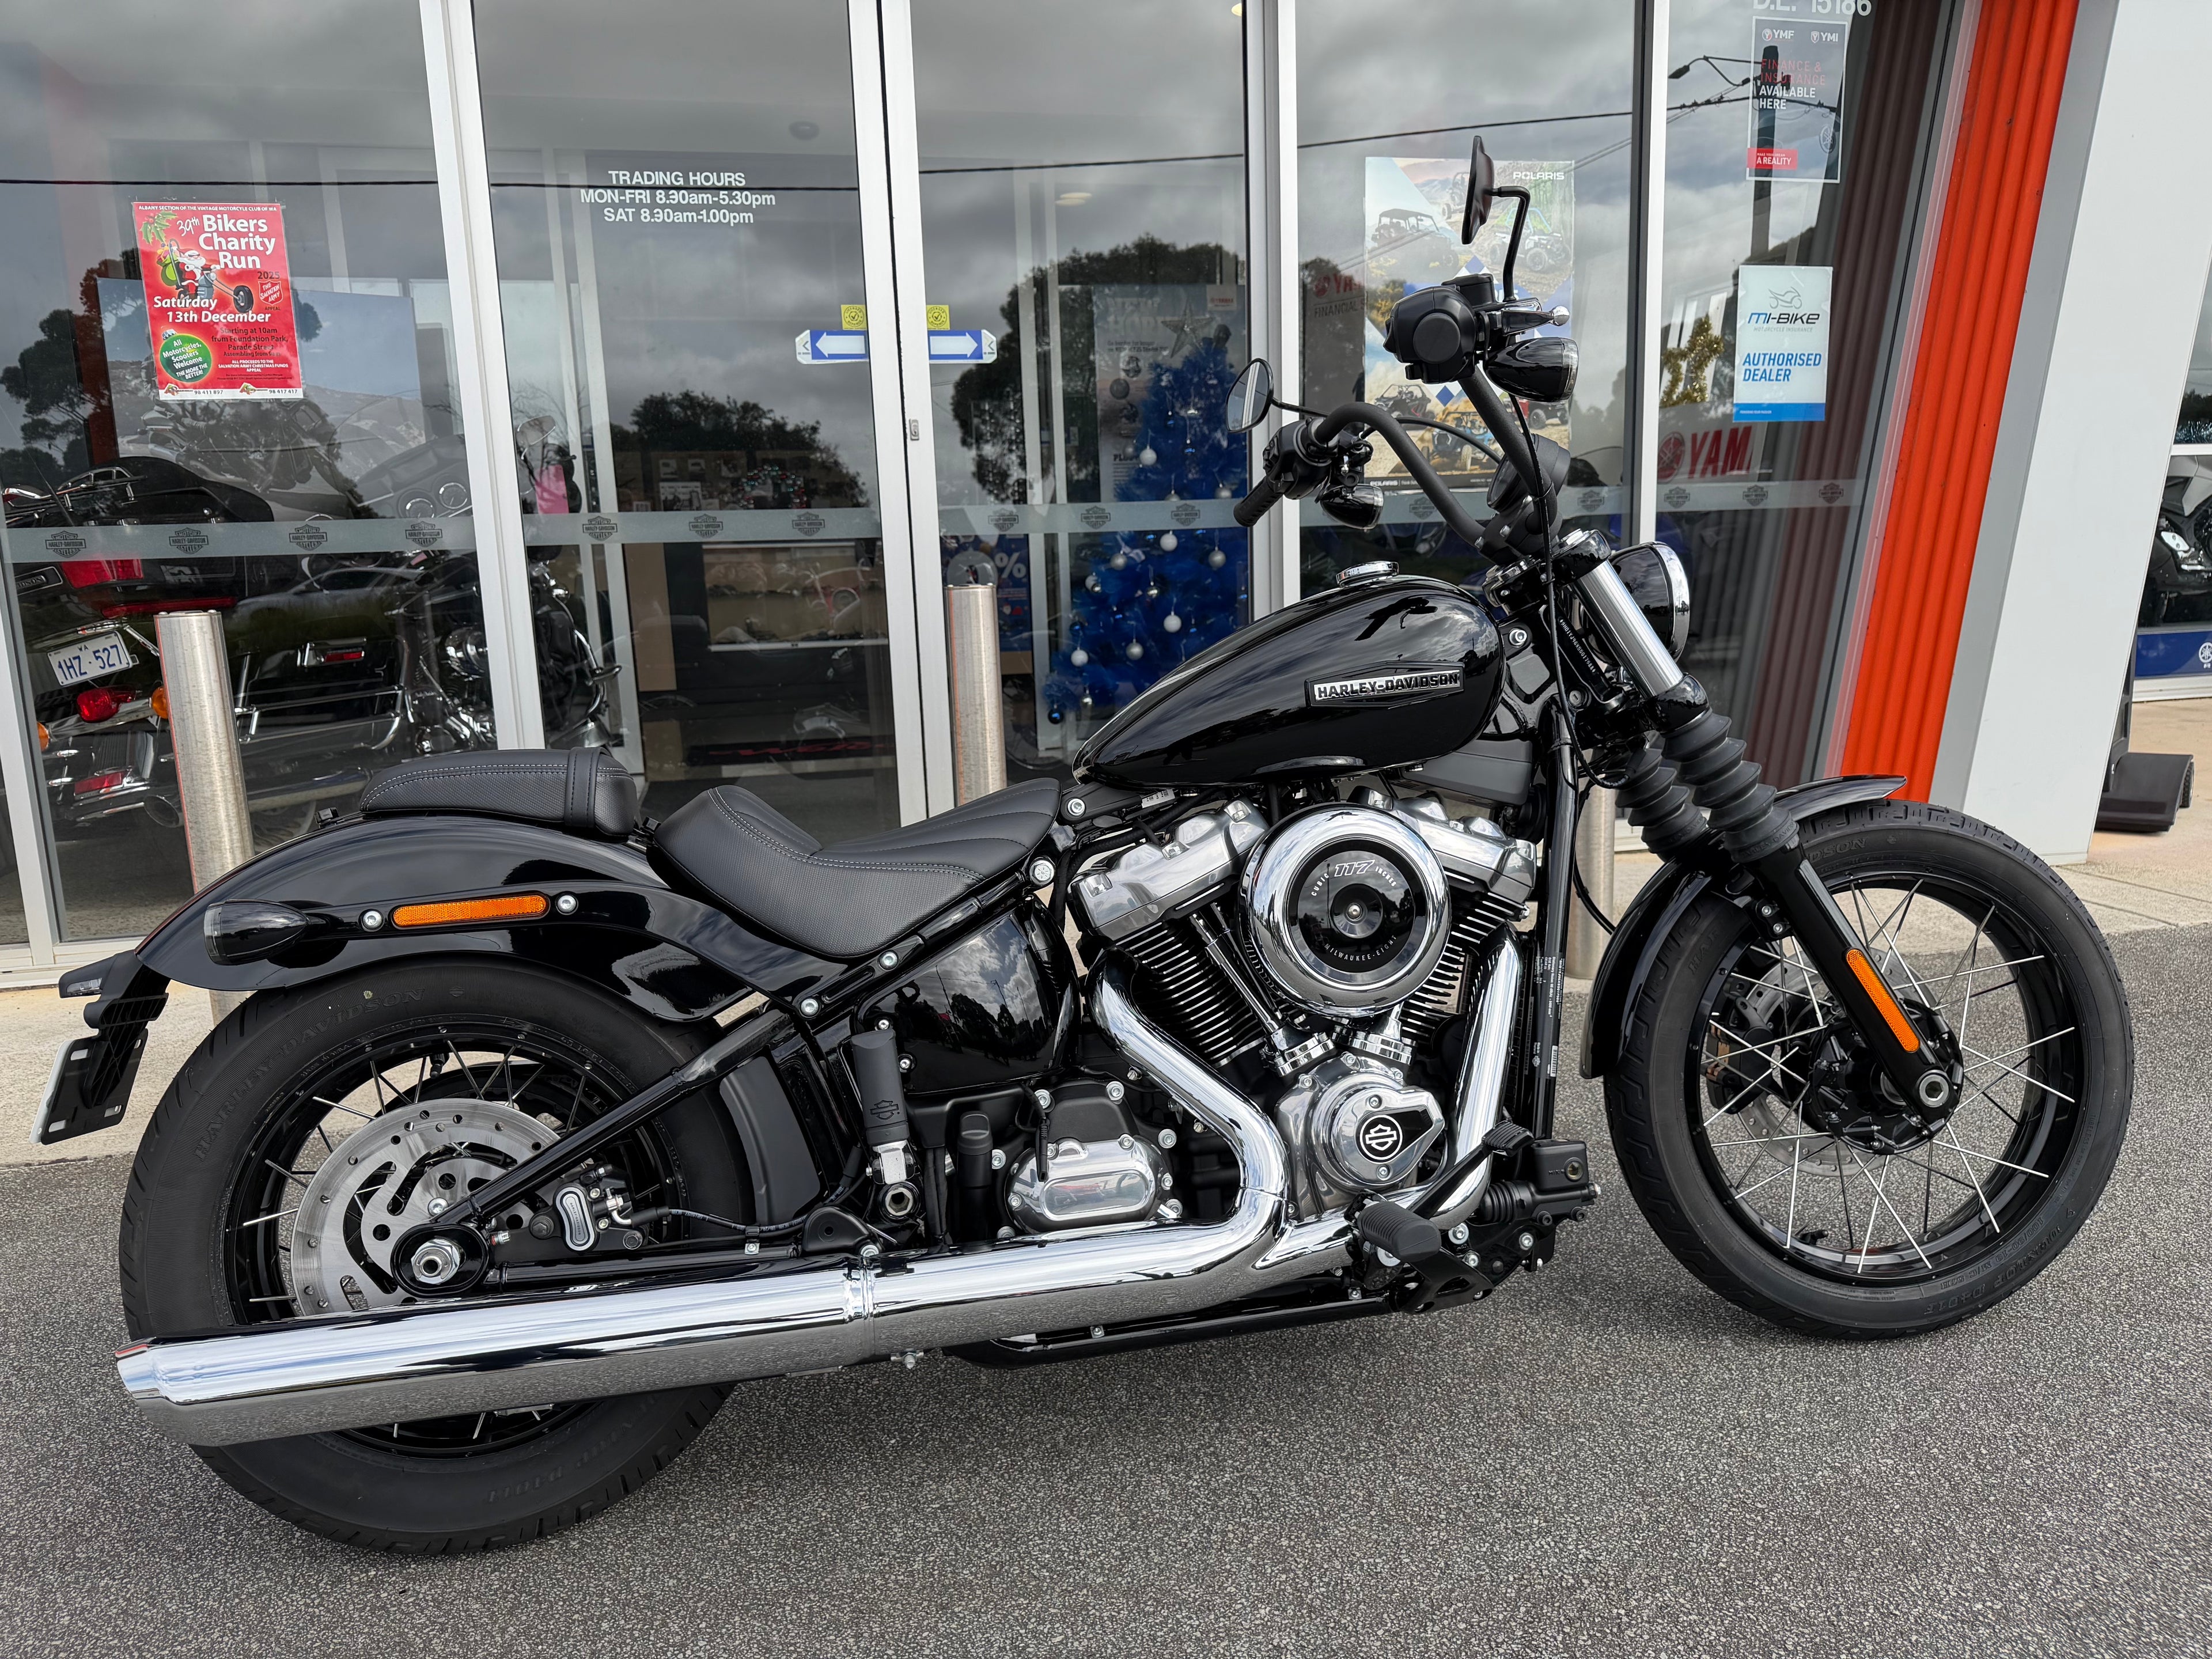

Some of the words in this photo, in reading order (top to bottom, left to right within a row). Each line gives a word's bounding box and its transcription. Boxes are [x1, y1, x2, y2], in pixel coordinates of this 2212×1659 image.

[1773, 29, 1795, 39] YMF
[1820, 32, 1839, 42] YMI
[1762, 59, 1810, 71] FINANCE
[1815, 62, 1821, 72] &
[1760, 72, 1825, 85] INSURANCE
[1759, 85, 1816, 98] AVAILABLE
[1759, 98, 1787, 109] HERE
[608, 171, 684, 185] TRADING
[689, 172, 746, 187] HOURS
[1513, 171, 1565, 180] POLARIS
[580, 189, 650, 203] MON-FRI
[656, 189, 776, 208] 8.30am-5.30pm
[604, 208, 635, 222] SAT
[640, 209, 754, 226] 8.30am-1.00pm
[176, 217, 200, 236] 39th
[202, 214, 268, 232] Bikers
[199, 233, 275, 255] Charity
[218, 252, 260, 268] Run
[257, 271, 280, 279] 2025
[262, 282, 271, 291] THE
[153, 296, 217, 310] Saturday
[268, 291, 280, 302] ARMY
[167, 311, 197, 323] 13th
[202, 310, 271, 323] December
[220, 327, 249, 335] Starting
[173, 339, 183, 347] All
[162, 342, 202, 358] Motorcycles,
[171, 350, 199, 362] Scooters
[173, 357, 203, 369] Welcome
[1743, 353, 1822, 366] AUTHORISED
[185, 366, 199, 374] MORE
[1743, 368, 1791, 381] DEALER
[1317, 673, 1459, 698] HARLEY-DAVIDSON
[1334, 859, 1376, 877] 117
[1375, 865, 1396, 887] INCHES
[1311, 872, 1330, 897] CUBIC
[1324, 934, 1397, 961] MILWAUKEE-EIGHT
[195, 987, 425, 1162] HARLEY-DAVIDSON
